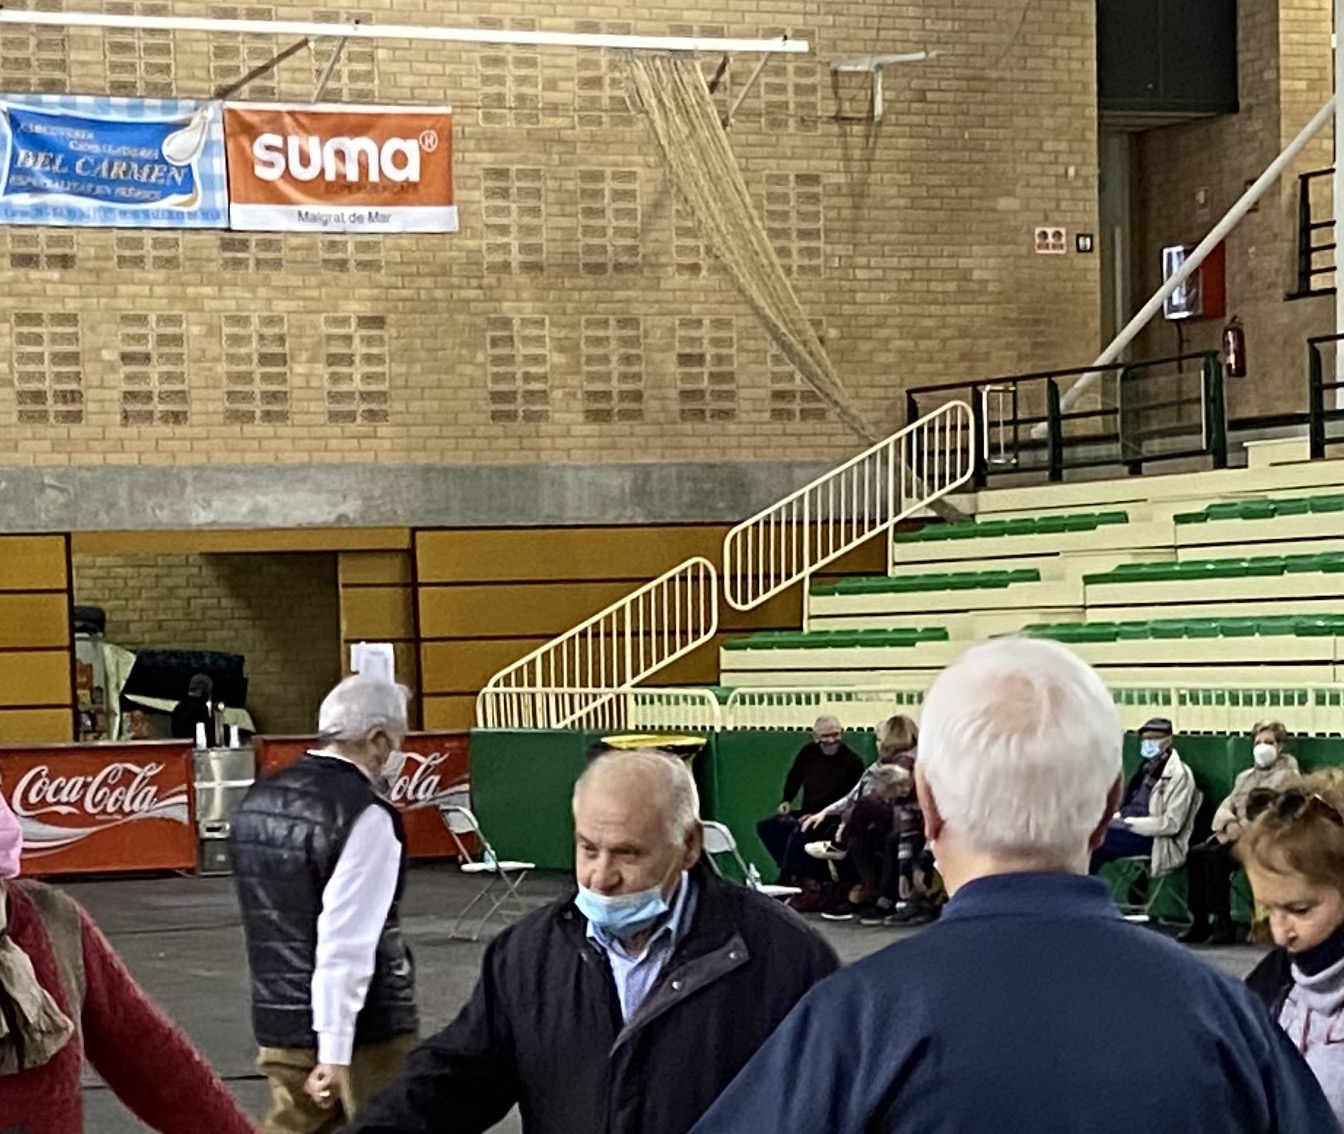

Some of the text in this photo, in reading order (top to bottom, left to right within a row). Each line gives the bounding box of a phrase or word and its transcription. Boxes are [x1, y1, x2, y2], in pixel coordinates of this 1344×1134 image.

[16, 149, 186, 187] DEL CARMEN
[253, 133, 421, 182] suma
[297, 210, 393, 226] Malgrat de Mar
[12, 762, 166, 816] Coca-Cola
